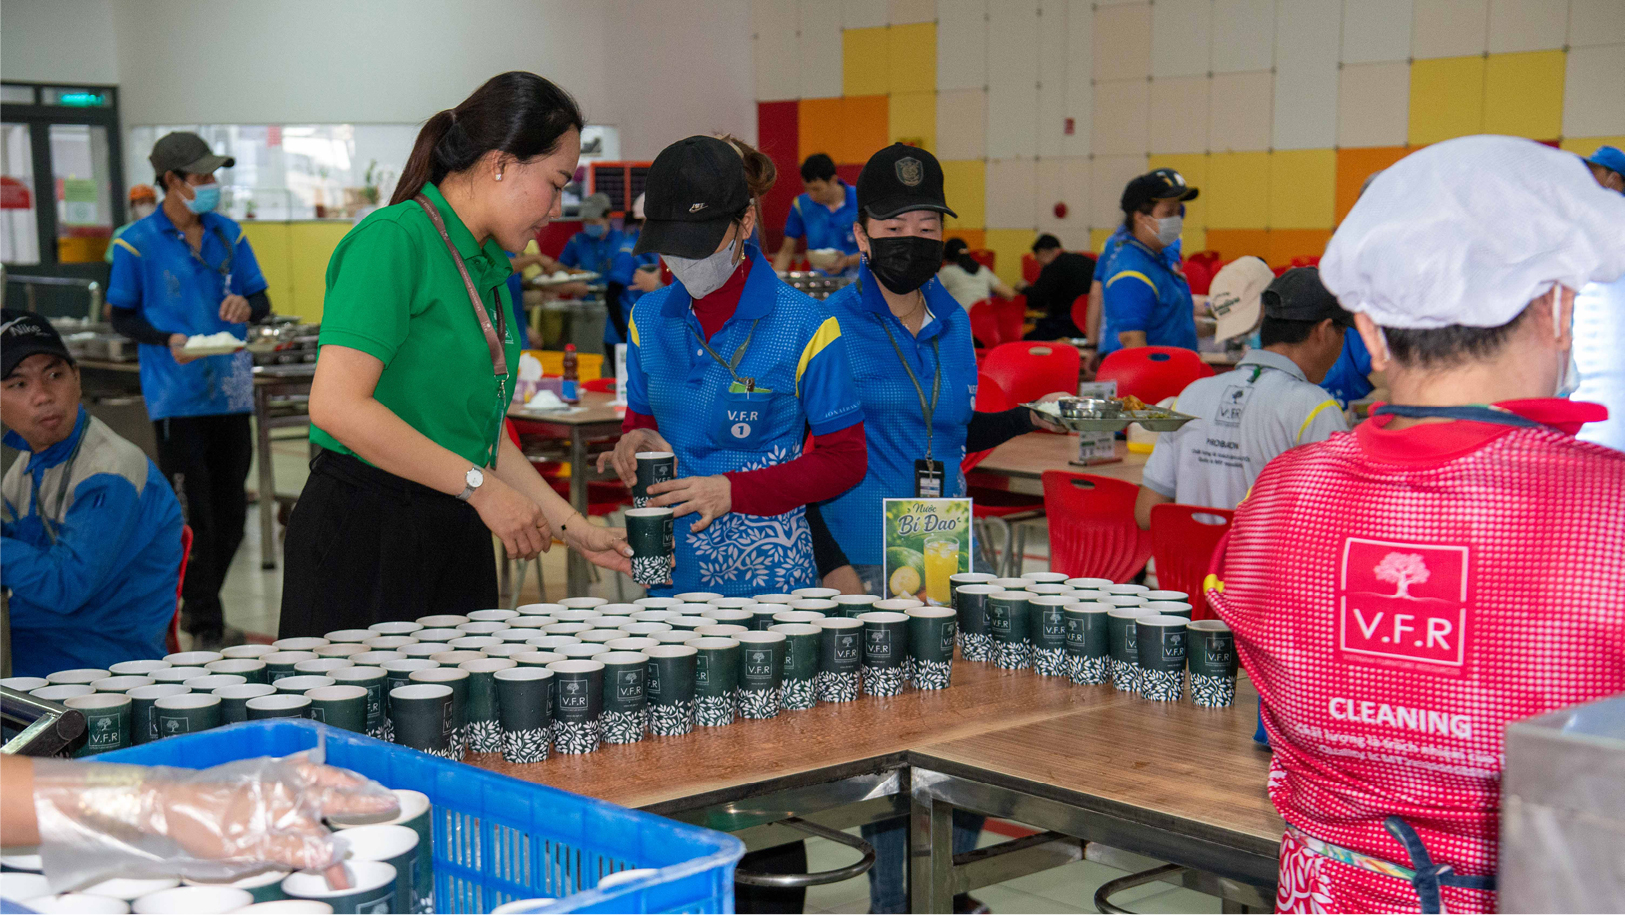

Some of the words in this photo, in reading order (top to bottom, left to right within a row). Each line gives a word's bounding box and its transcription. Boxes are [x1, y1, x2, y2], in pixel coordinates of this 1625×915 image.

[728, 410, 758, 421] V.F.R
[913, 503, 937, 513] Nước
[898, 515, 921, 535] Bí
[923, 514, 957, 532] Đao
[1353, 608, 1452, 650] V.F.R
[836, 649, 857, 658] V.F.R
[867, 644, 889, 653] V.F.R
[1165, 647, 1185, 656] V.F.R
[1207, 653, 1230, 661] V.F.R
[748, 665, 770, 674] V.F.R
[620, 686, 642, 696] V.F.R
[562, 696, 586, 706] V.F.R
[1328, 697, 1472, 739] CLEANING
[92, 732, 118, 743] V.F.R
